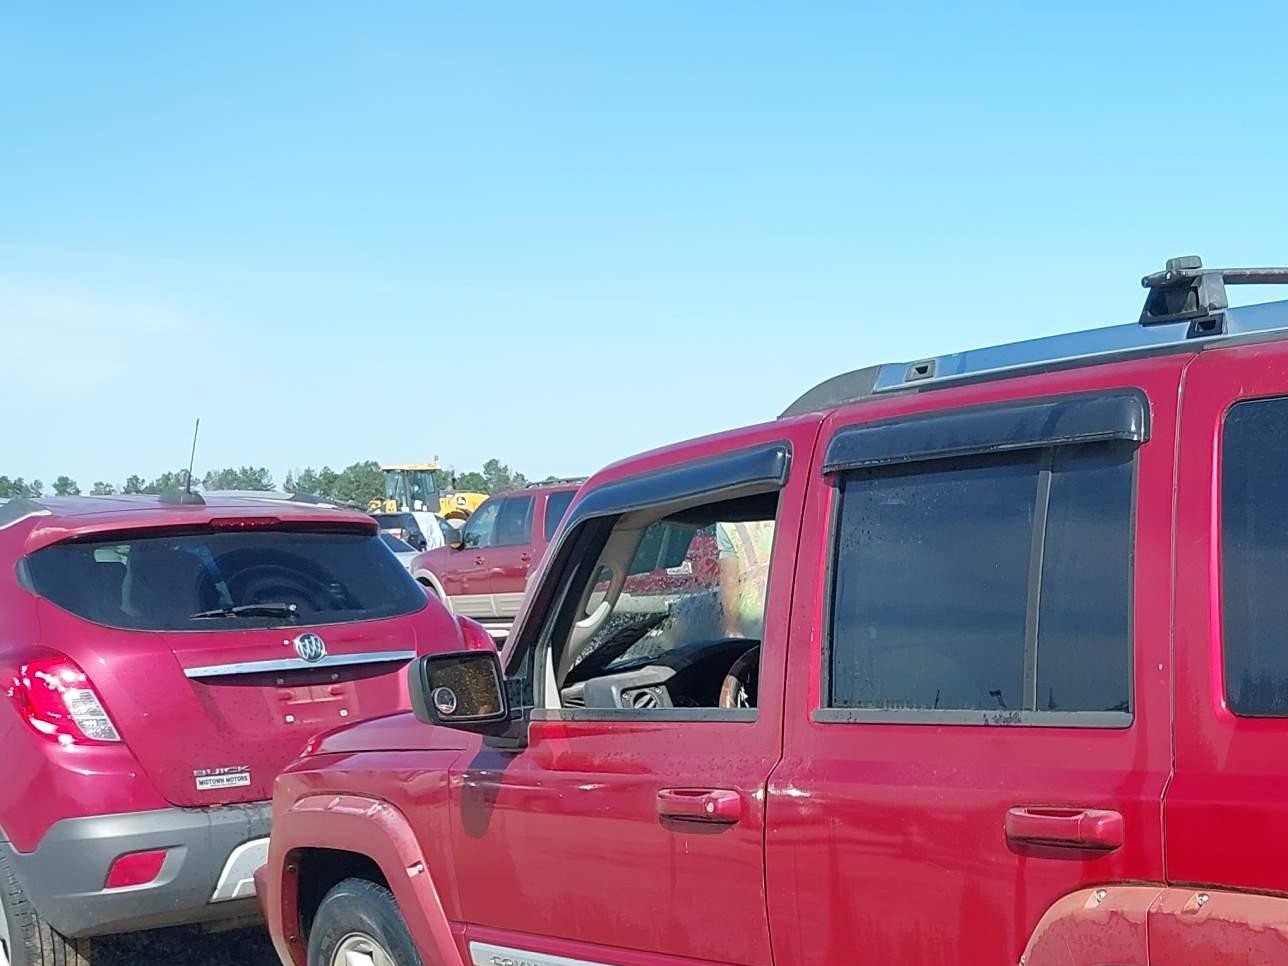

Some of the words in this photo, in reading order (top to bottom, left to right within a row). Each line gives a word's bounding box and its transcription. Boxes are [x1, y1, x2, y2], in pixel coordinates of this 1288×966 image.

[193, 764, 251, 776] BUICK
[198, 777, 225, 785] MIDTOWN
[225, 775, 249, 783] MOTORS
